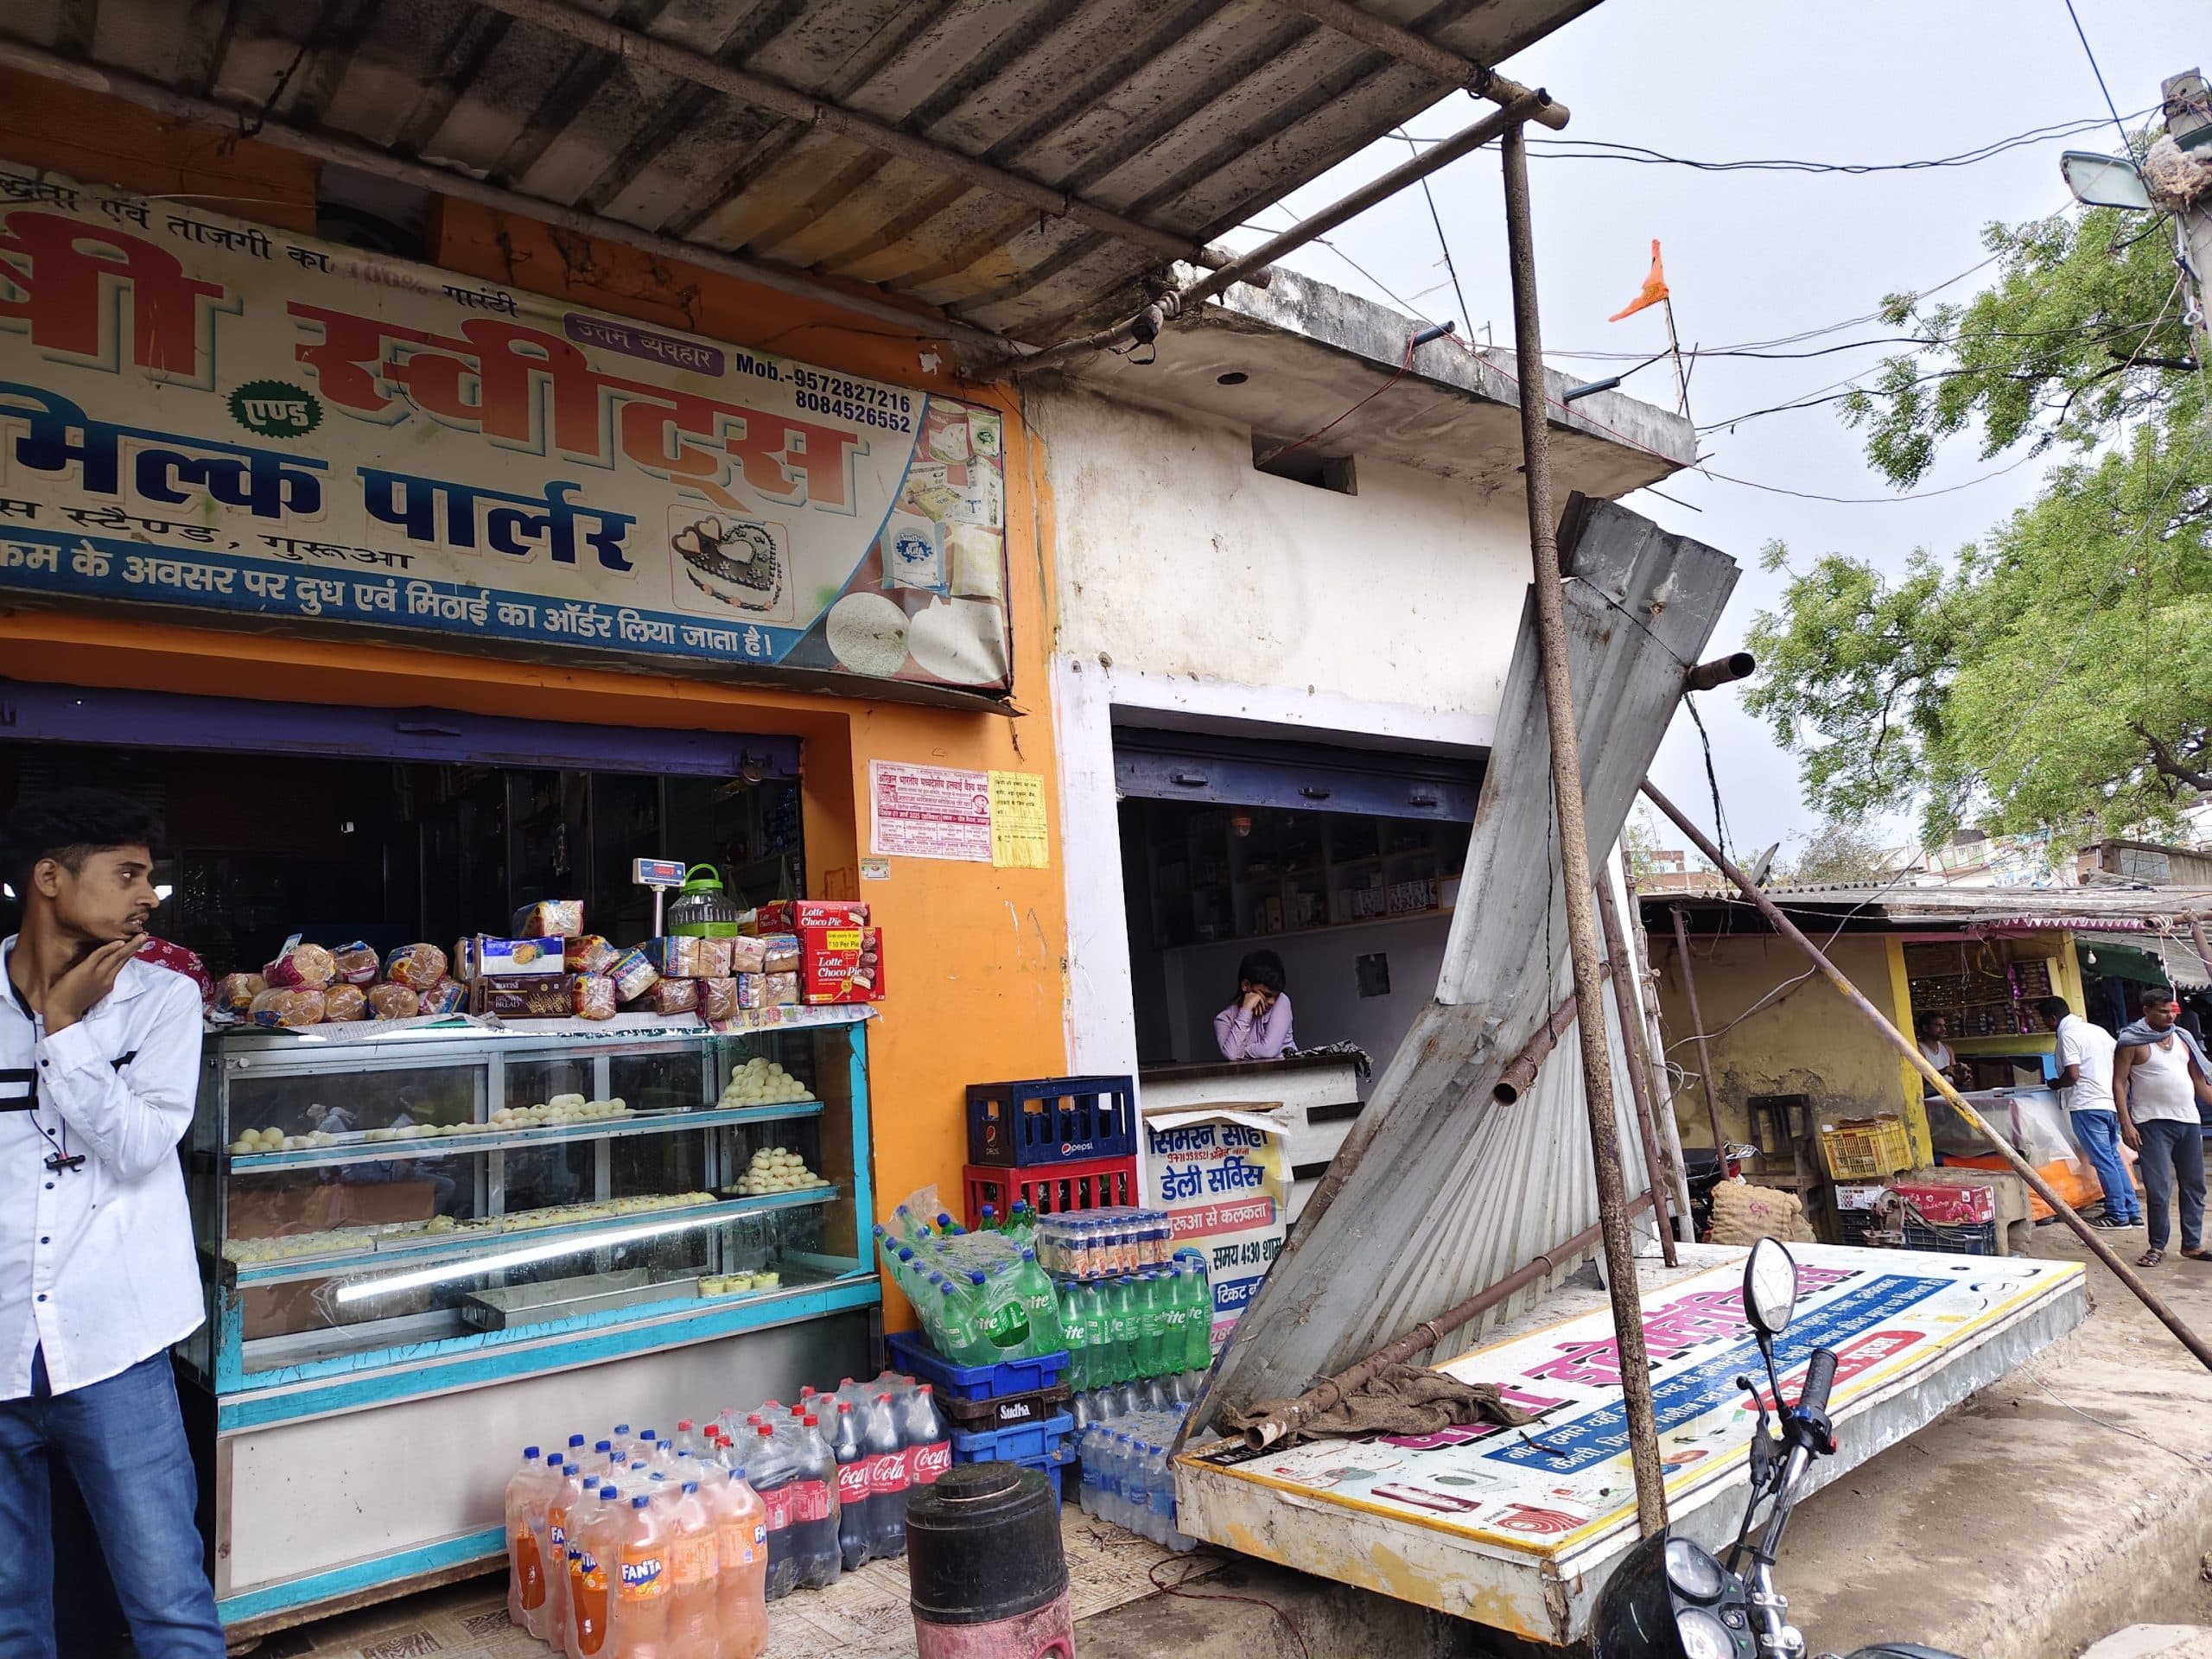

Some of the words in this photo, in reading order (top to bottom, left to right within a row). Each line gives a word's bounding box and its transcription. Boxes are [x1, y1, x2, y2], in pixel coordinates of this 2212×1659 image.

[96, 197, 150, 230] एवं
[167, 214, 272, 259] ताजगी
[286, 245, 331, 274] का
[639, 336, 714, 368] व्यवहार
[735, 353, 911, 413] Mob.-9572827216
[242, 399, 308, 427] एण्ड
[796, 391, 911, 433] 8084526552
[357, 467, 637, 572] पार्लर
[71, 539, 113, 577] के
[122, 556, 238, 594] अवसर
[243, 570, 289, 600] पर
[295, 576, 346, 615] दुध
[353, 578, 397, 612] एवं
[406, 582, 490, 626] मिठाई
[497, 601, 537, 628] का
[543, 602, 613, 638] ऑर्डर
[617, 607, 676, 645] लिया
[680, 624, 739, 652] जाता
[801, 918, 827, 926] Choco
[828, 917, 842, 926] Pie
[802, 907, 824, 917] Lotte
[817, 967, 846, 977] Choco
[848, 967, 862, 976] Pie
[818, 957, 843, 967] Lotte
[1071, 1142, 1093, 1152] pepsi
[1160, 1164, 1202, 1201] डेली
[1206, 1156, 1266, 1192] सर्विस
[1206, 1206, 1217, 1226] से
[1213, 1244, 1239, 1270] समय
[1241, 1243, 1260, 1264] 4:30
[1217, 1284, 1247, 1304] टिकट
[1000, 1402, 1031, 1420] Sudha
[1545, 1425, 1590, 1444] हमारे
[621, 1558, 662, 1580] FANTA
